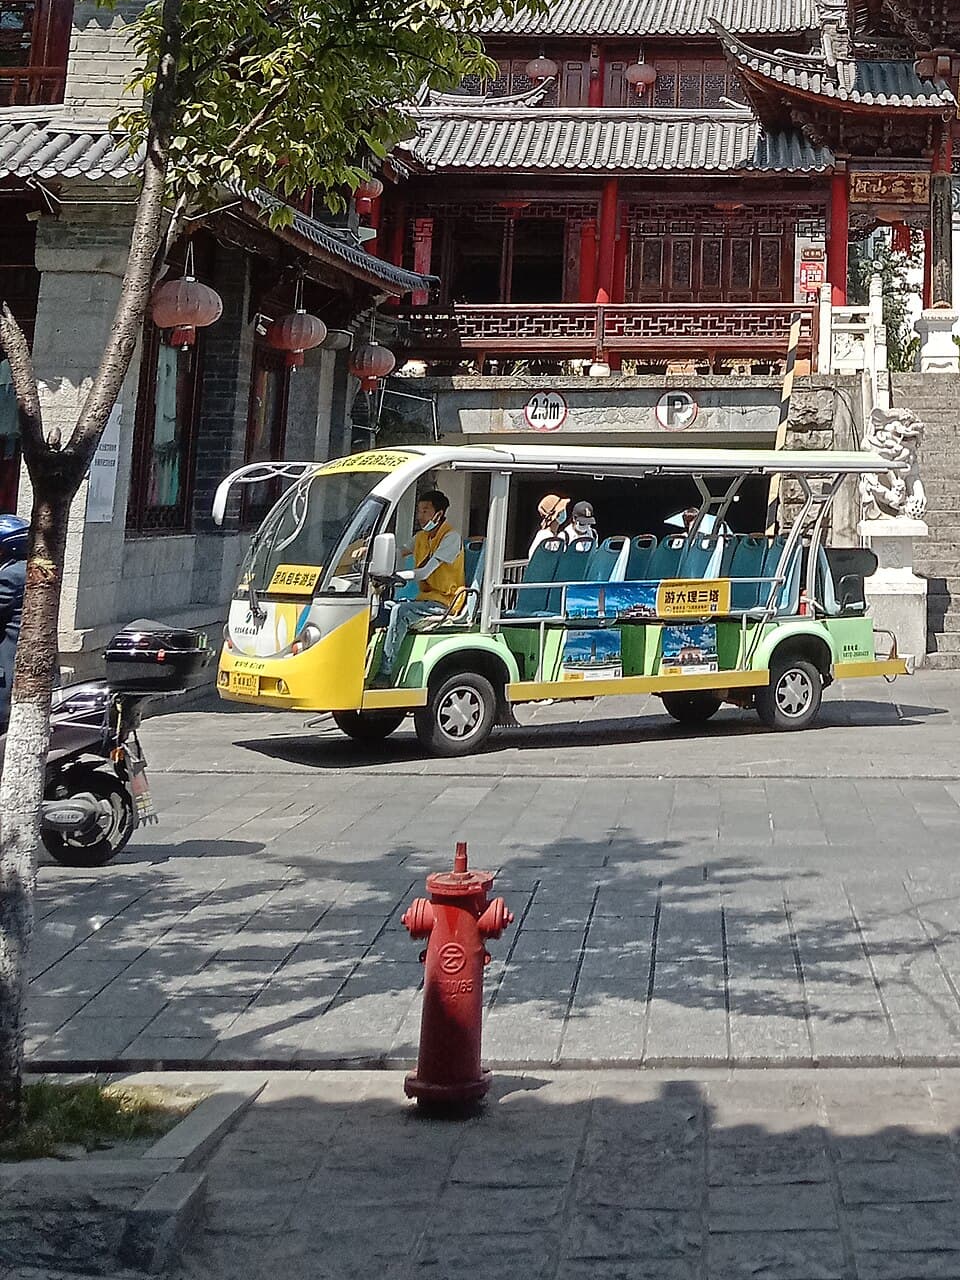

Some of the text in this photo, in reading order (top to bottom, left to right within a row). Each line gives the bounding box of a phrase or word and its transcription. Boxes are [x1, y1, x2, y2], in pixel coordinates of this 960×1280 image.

[530, 398, 560, 420] 2.3m
[667, 394, 690, 425] P
[665, 589, 719, 603] 游大理三塔
